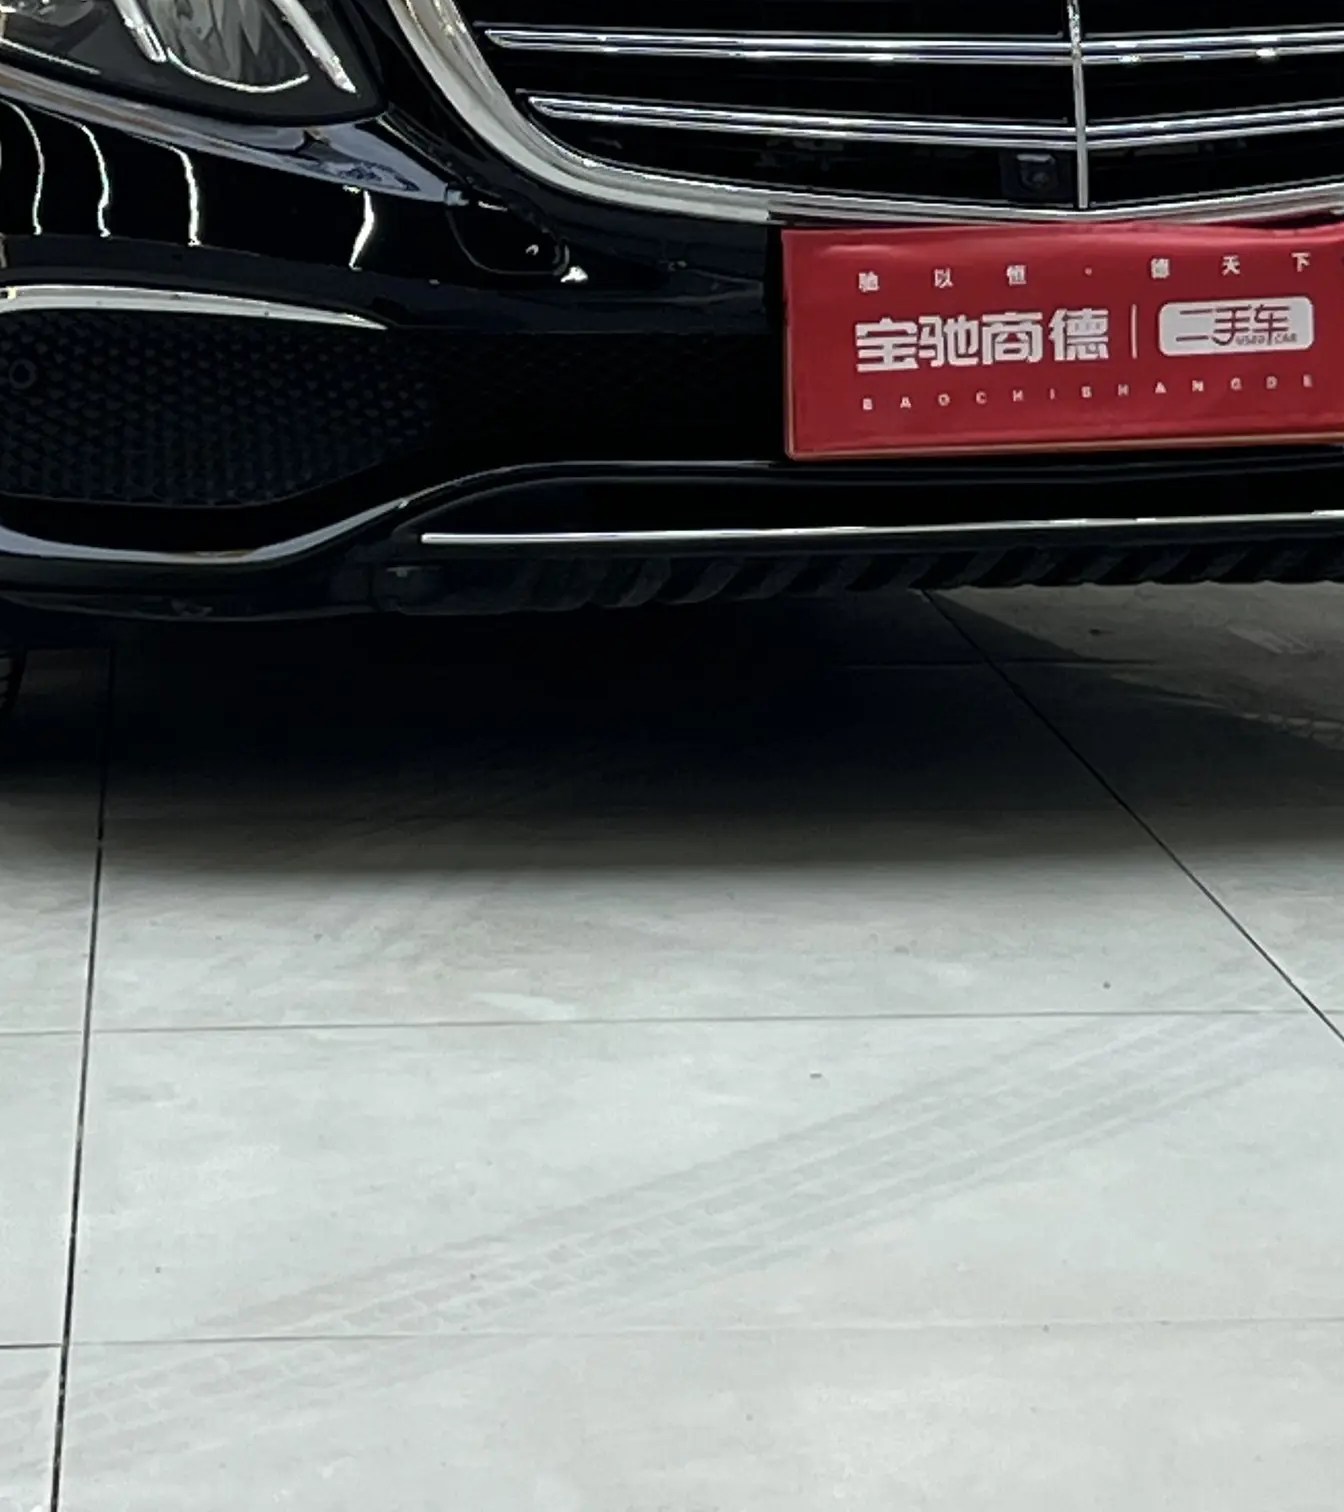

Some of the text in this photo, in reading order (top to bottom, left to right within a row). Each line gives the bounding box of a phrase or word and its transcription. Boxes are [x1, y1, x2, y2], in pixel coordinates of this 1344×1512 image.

[855, 307, 1110, 372] 宝驰商德
[1175, 304, 1292, 346] 二手车
